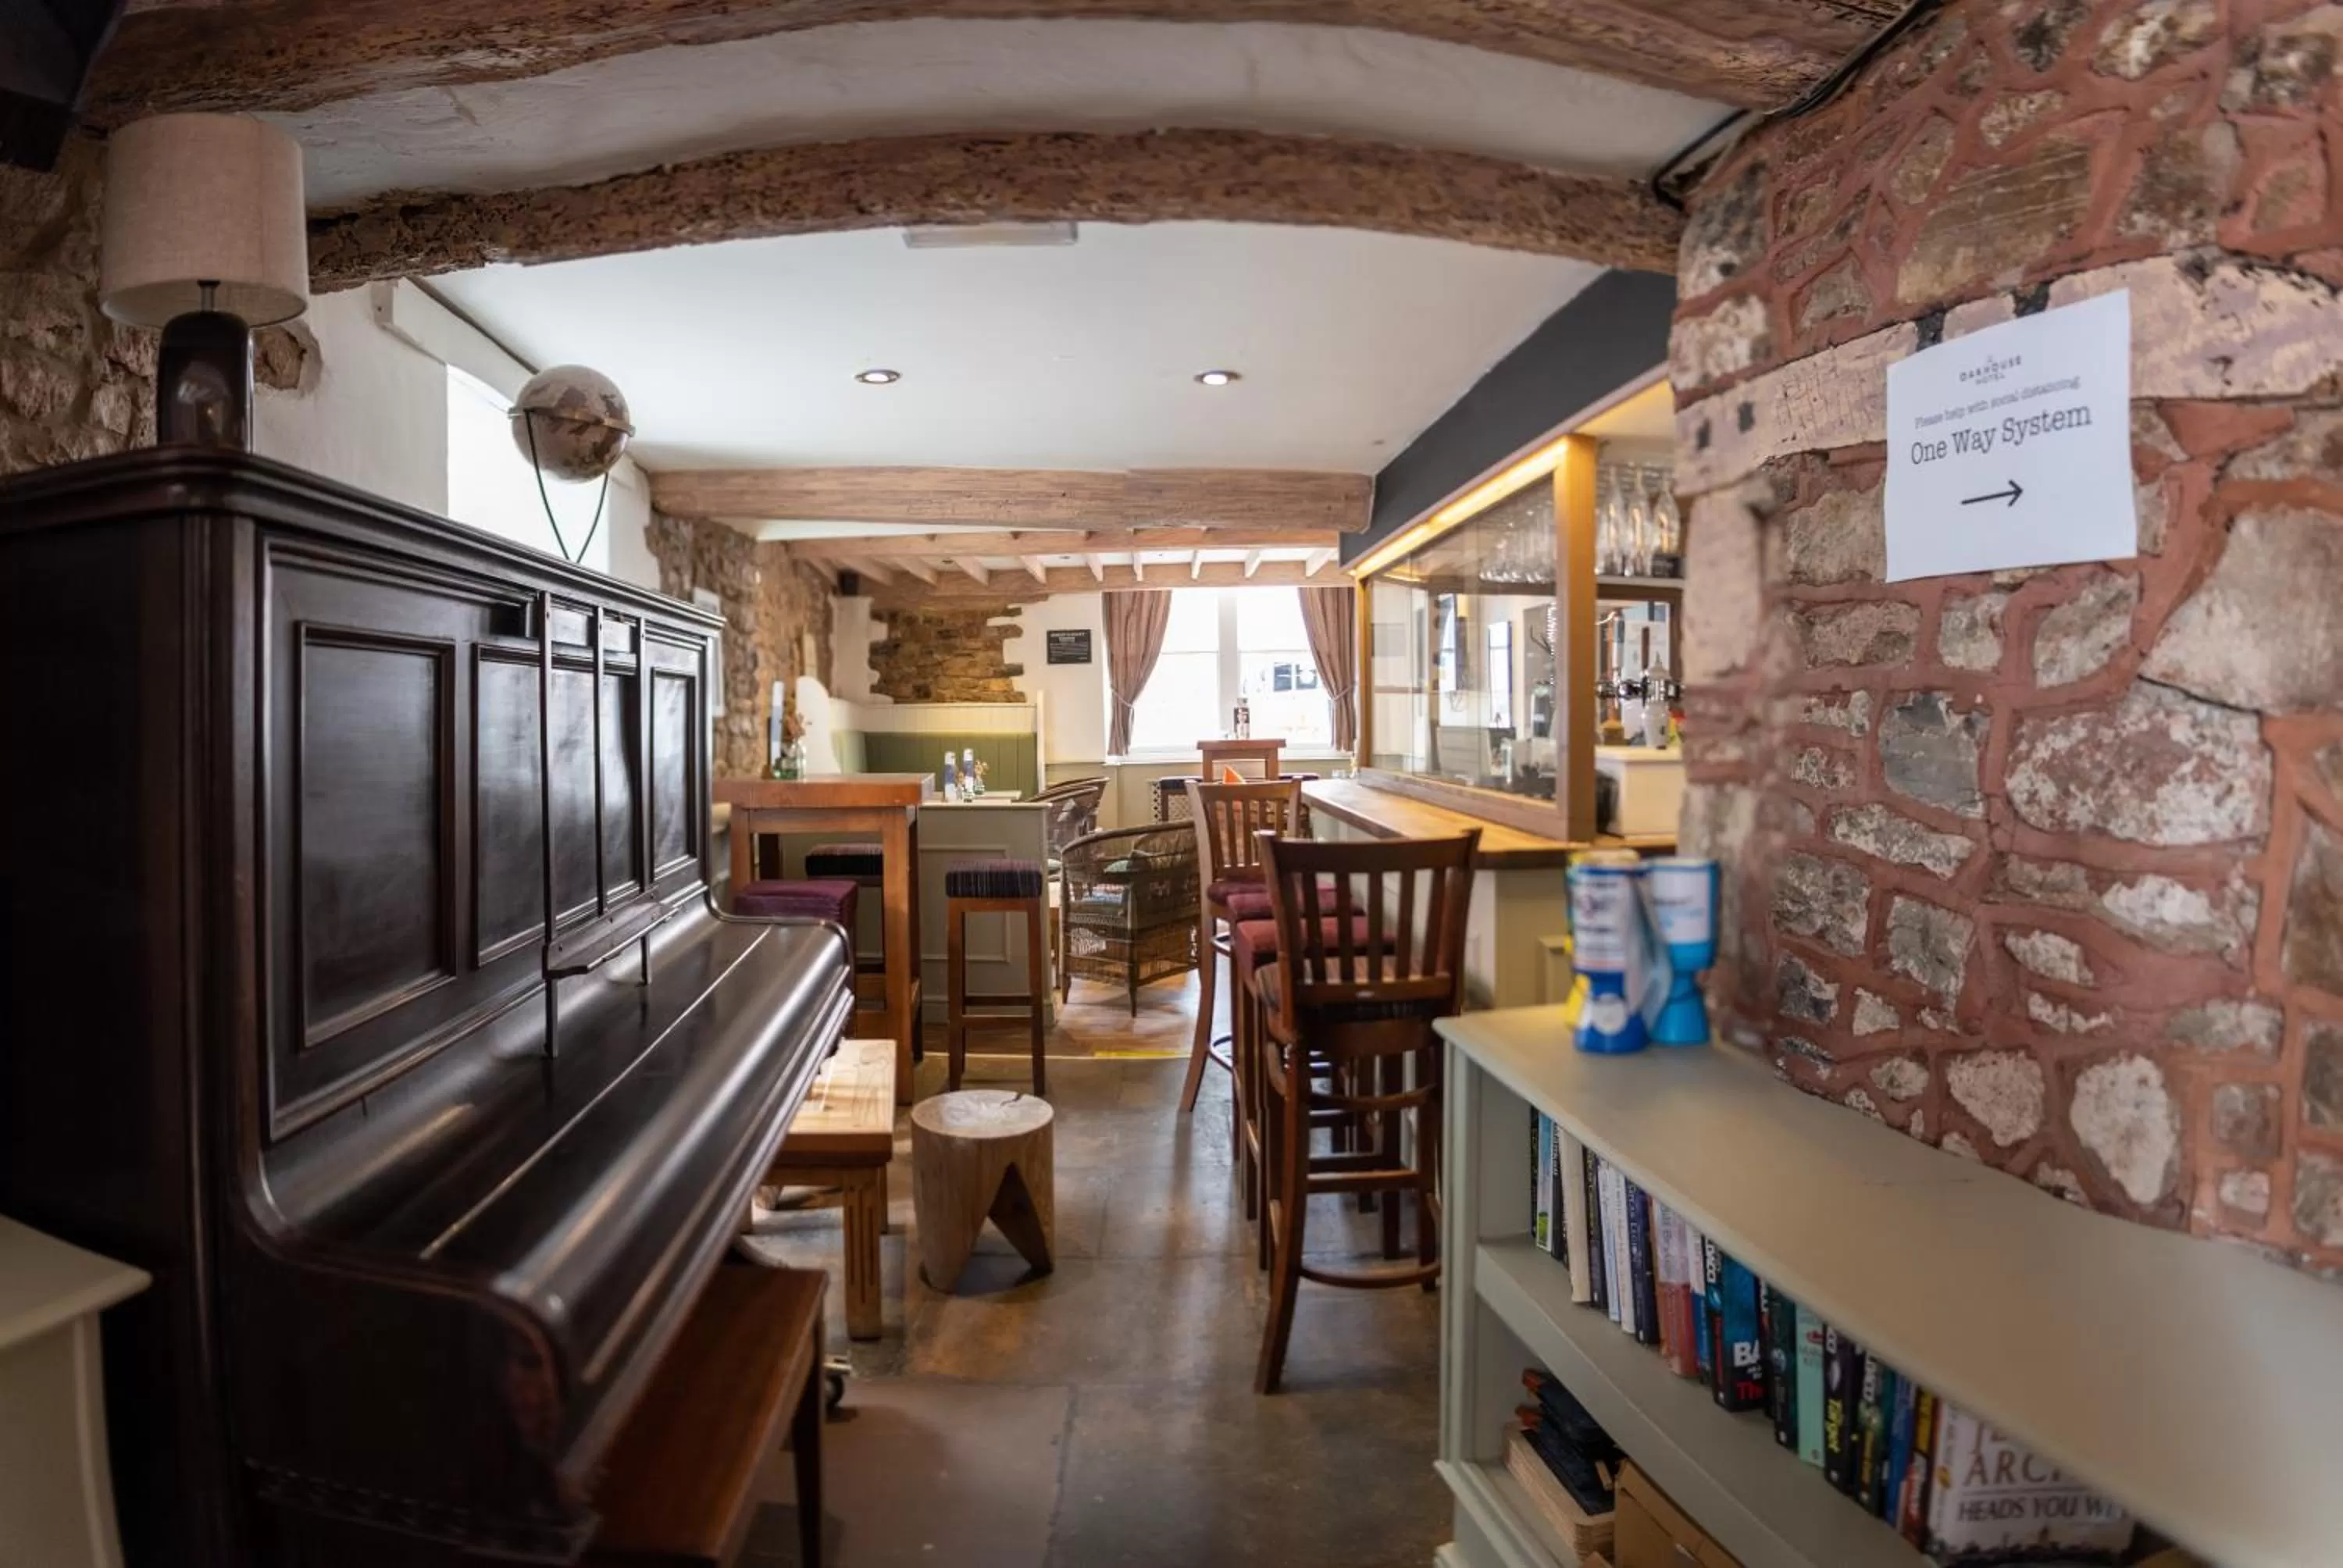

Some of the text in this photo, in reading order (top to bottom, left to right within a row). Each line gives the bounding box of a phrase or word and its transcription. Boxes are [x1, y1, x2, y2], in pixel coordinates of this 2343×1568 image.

[1914, 413, 1943, 429] Please
[1944, 407, 1966, 422] help
[1967, 399, 1989, 415] with
[1991, 390, 2019, 409] social
[1910, 404, 2092, 465] One Way System
[1825, 1398, 1844, 1454] Target
[1958, 1497, 2027, 1522] HEADS
[2032, 1495, 2080, 1519] YOU
